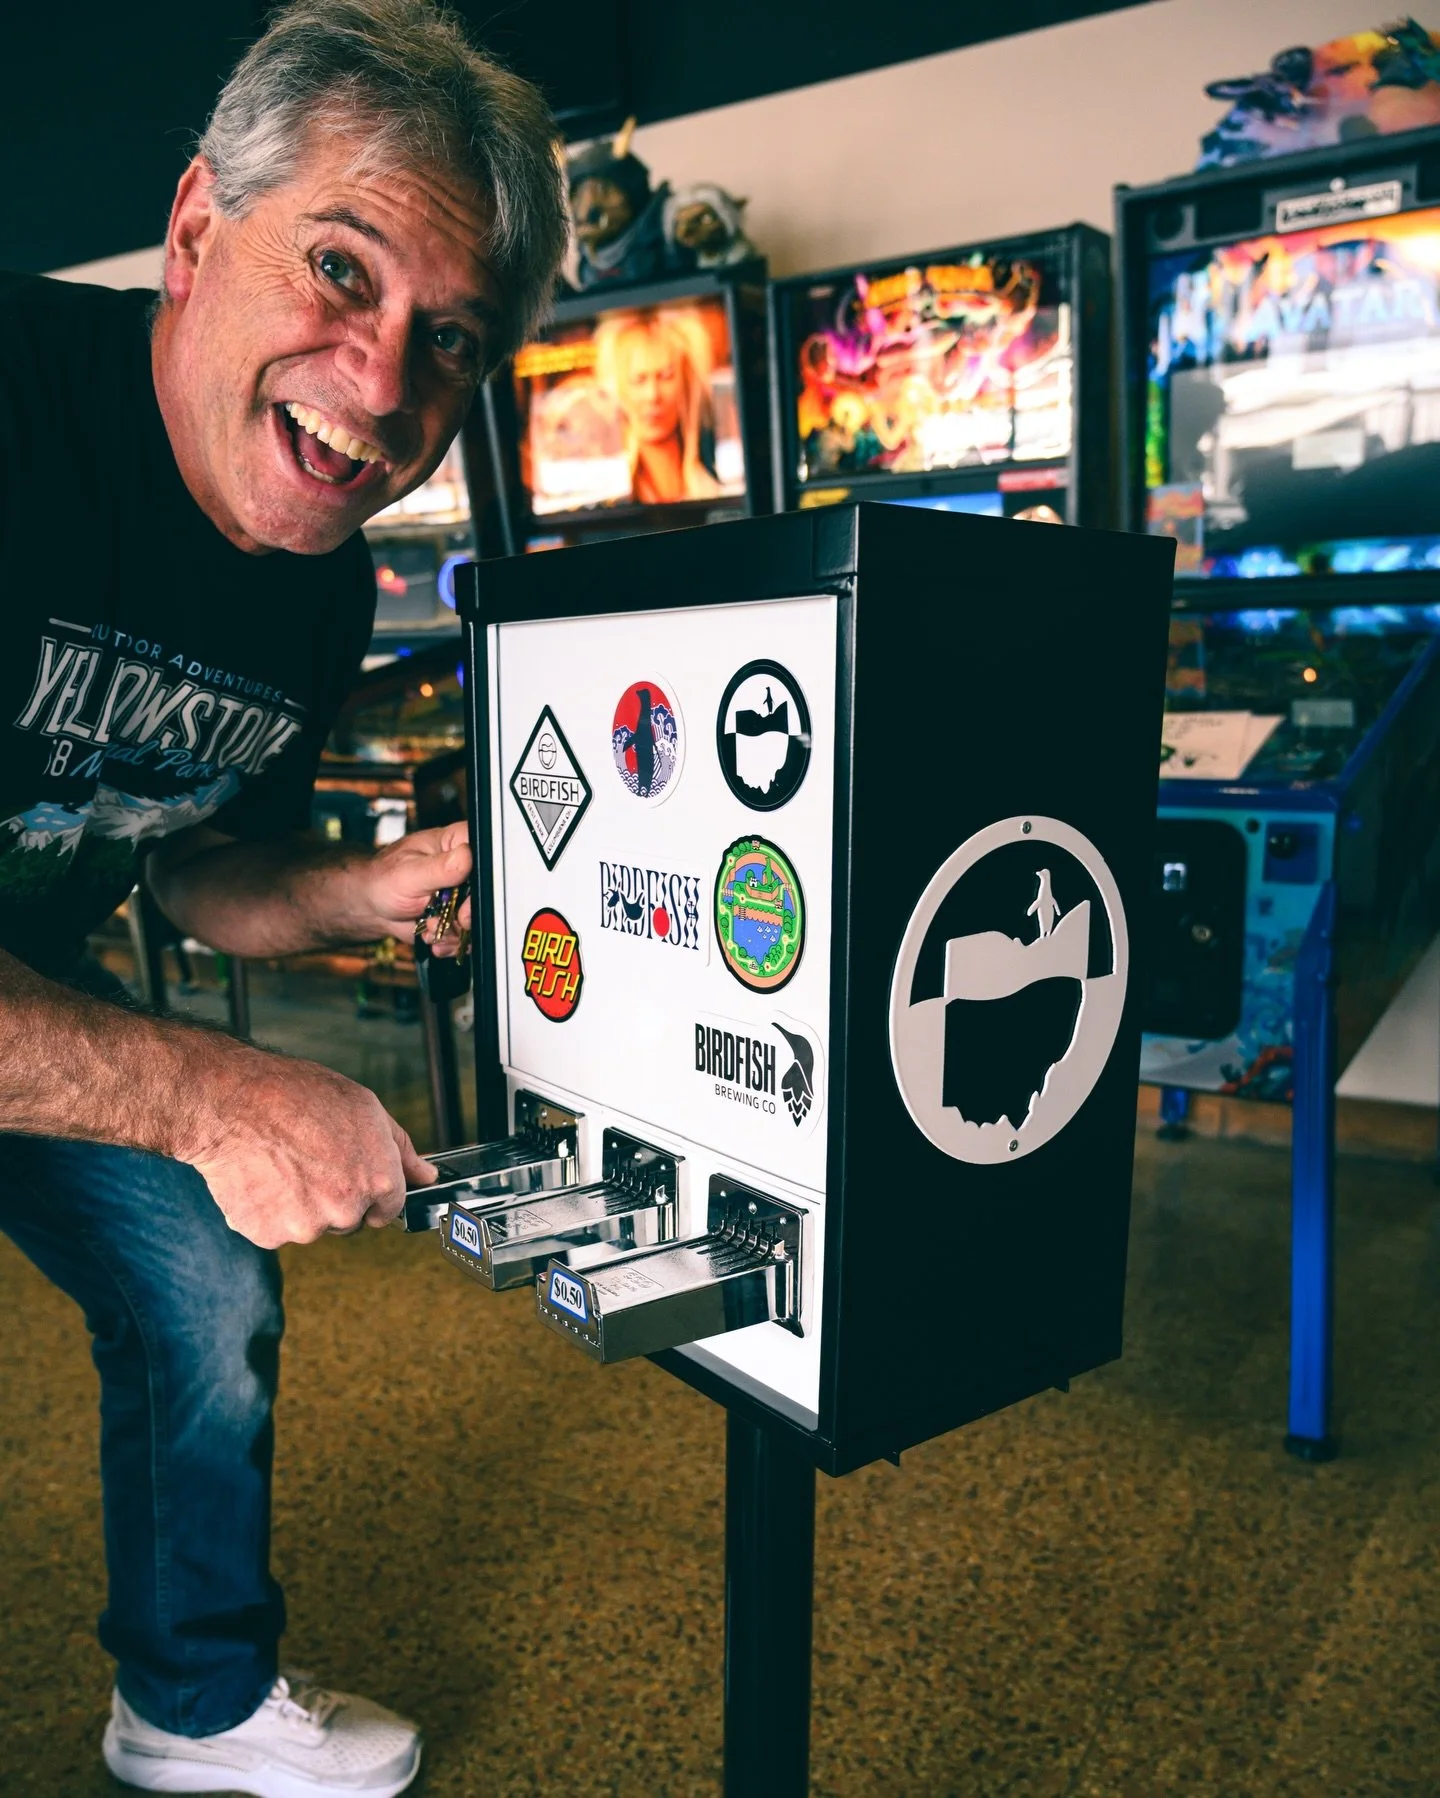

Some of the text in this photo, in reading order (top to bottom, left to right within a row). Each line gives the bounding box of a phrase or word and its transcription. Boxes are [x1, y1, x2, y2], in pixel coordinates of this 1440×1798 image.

[168, 653, 285, 703] ADVENTURES
[520, 776, 580, 803] BIRDFISH
[599, 861, 701, 950] BIRDFISH
[523, 929, 577, 967] BIRD
[526, 965, 581, 1001] FISH
[695, 1022, 776, 1096] BIRDFISH
[714, 1083, 776, 1115] BREWING CO
[454, 1218, 478, 1247] $0.50
[554, 1276, 583, 1310] $0.50
